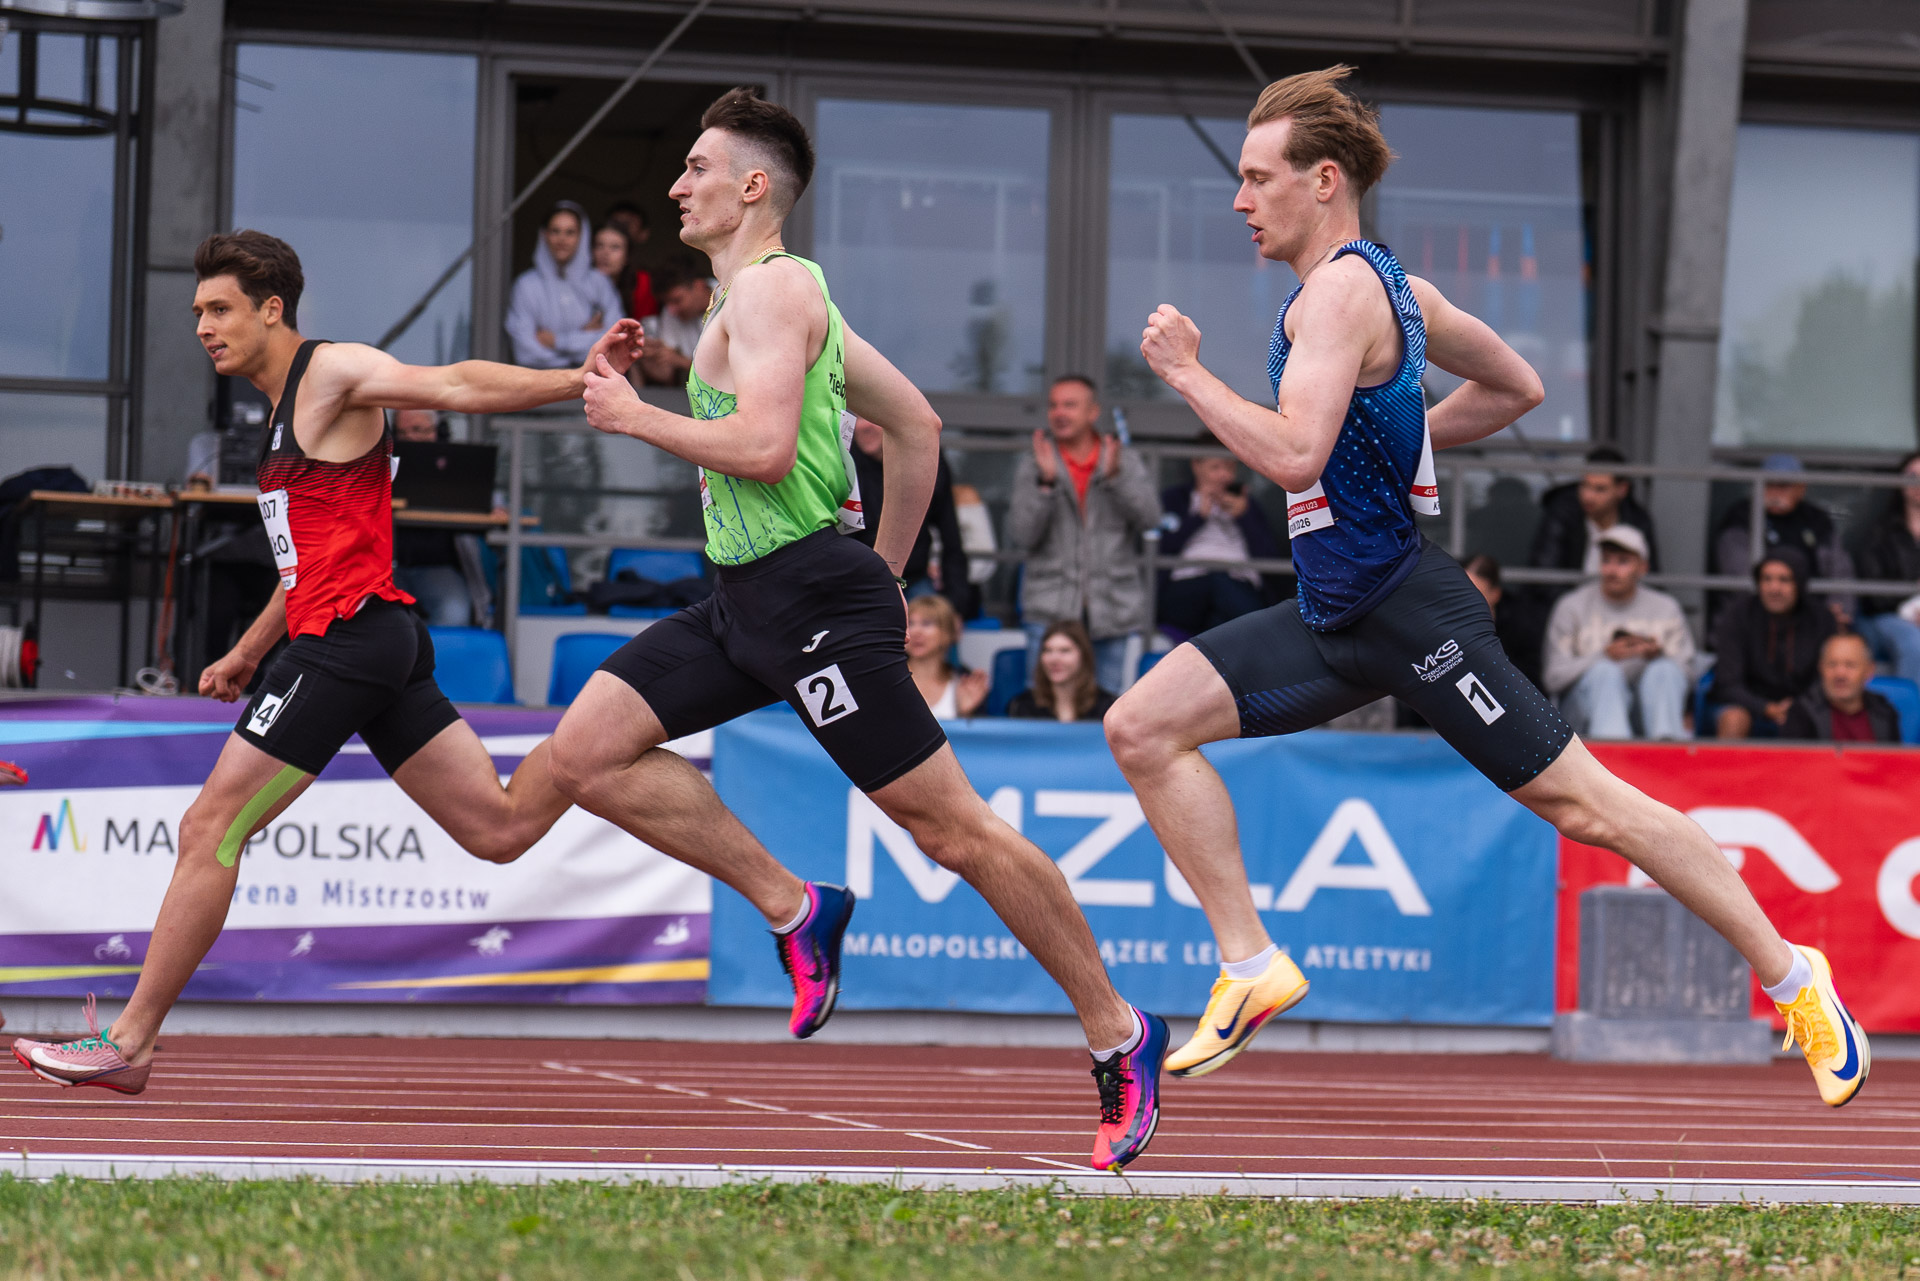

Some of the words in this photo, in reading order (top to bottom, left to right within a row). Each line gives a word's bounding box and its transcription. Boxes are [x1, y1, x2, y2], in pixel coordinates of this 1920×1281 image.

[1411, 639, 1459, 675] MKS
[1420, 650, 1464, 681] Czechowice
[808, 676, 847, 721] 2
[1468, 680, 1496, 712] 1
[255, 703, 276, 727] 4
[104, 818, 424, 861] MAPOLSKA
[234, 884, 298, 906] rena
[322, 880, 490, 910] Mistrzostw
[1099, 939, 1168, 967] ĄZEK
[1303, 944, 1432, 971] ATLETYKI
